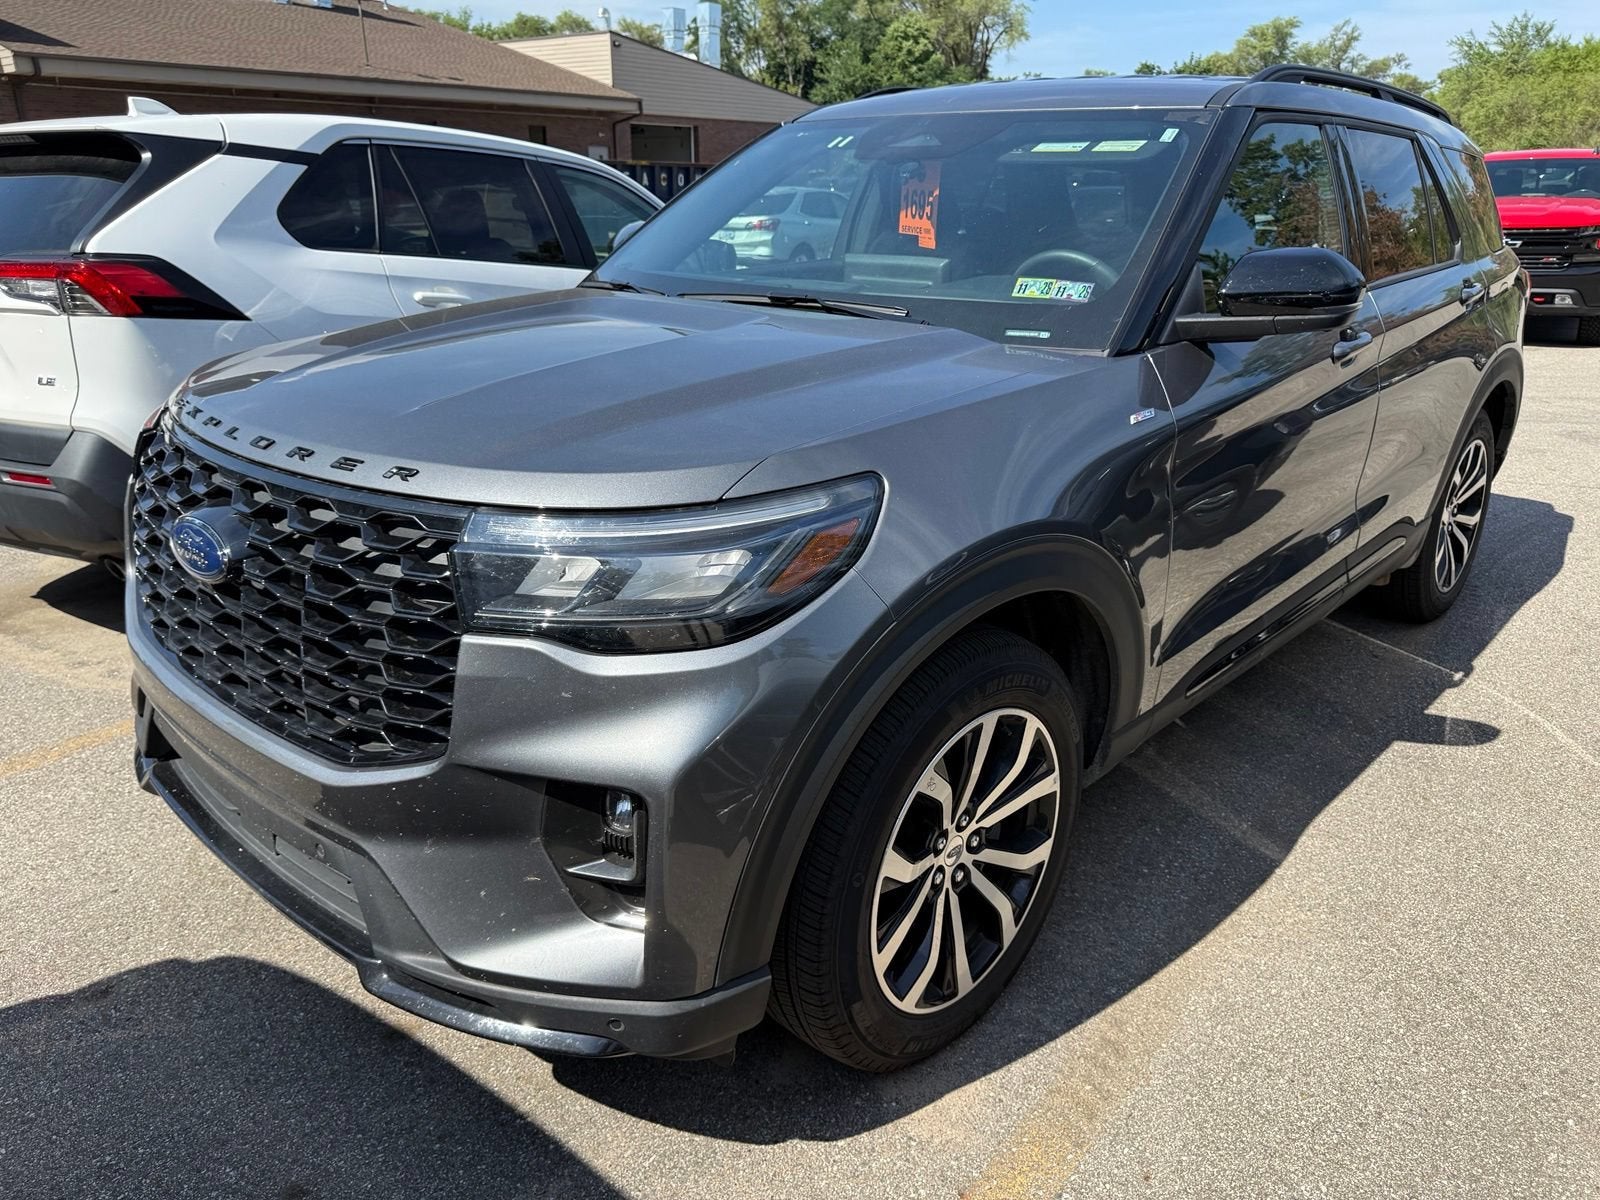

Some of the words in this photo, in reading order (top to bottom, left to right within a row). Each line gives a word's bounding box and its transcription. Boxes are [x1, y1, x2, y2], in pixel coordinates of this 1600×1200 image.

[901, 225, 922, 235] SERVICE
[1017, 283, 1028, 294] 11
[1055, 286, 1067, 297] 11
[176, 399, 420, 482] EXPLORER
[985, 672, 1051, 696] MICHELIN
